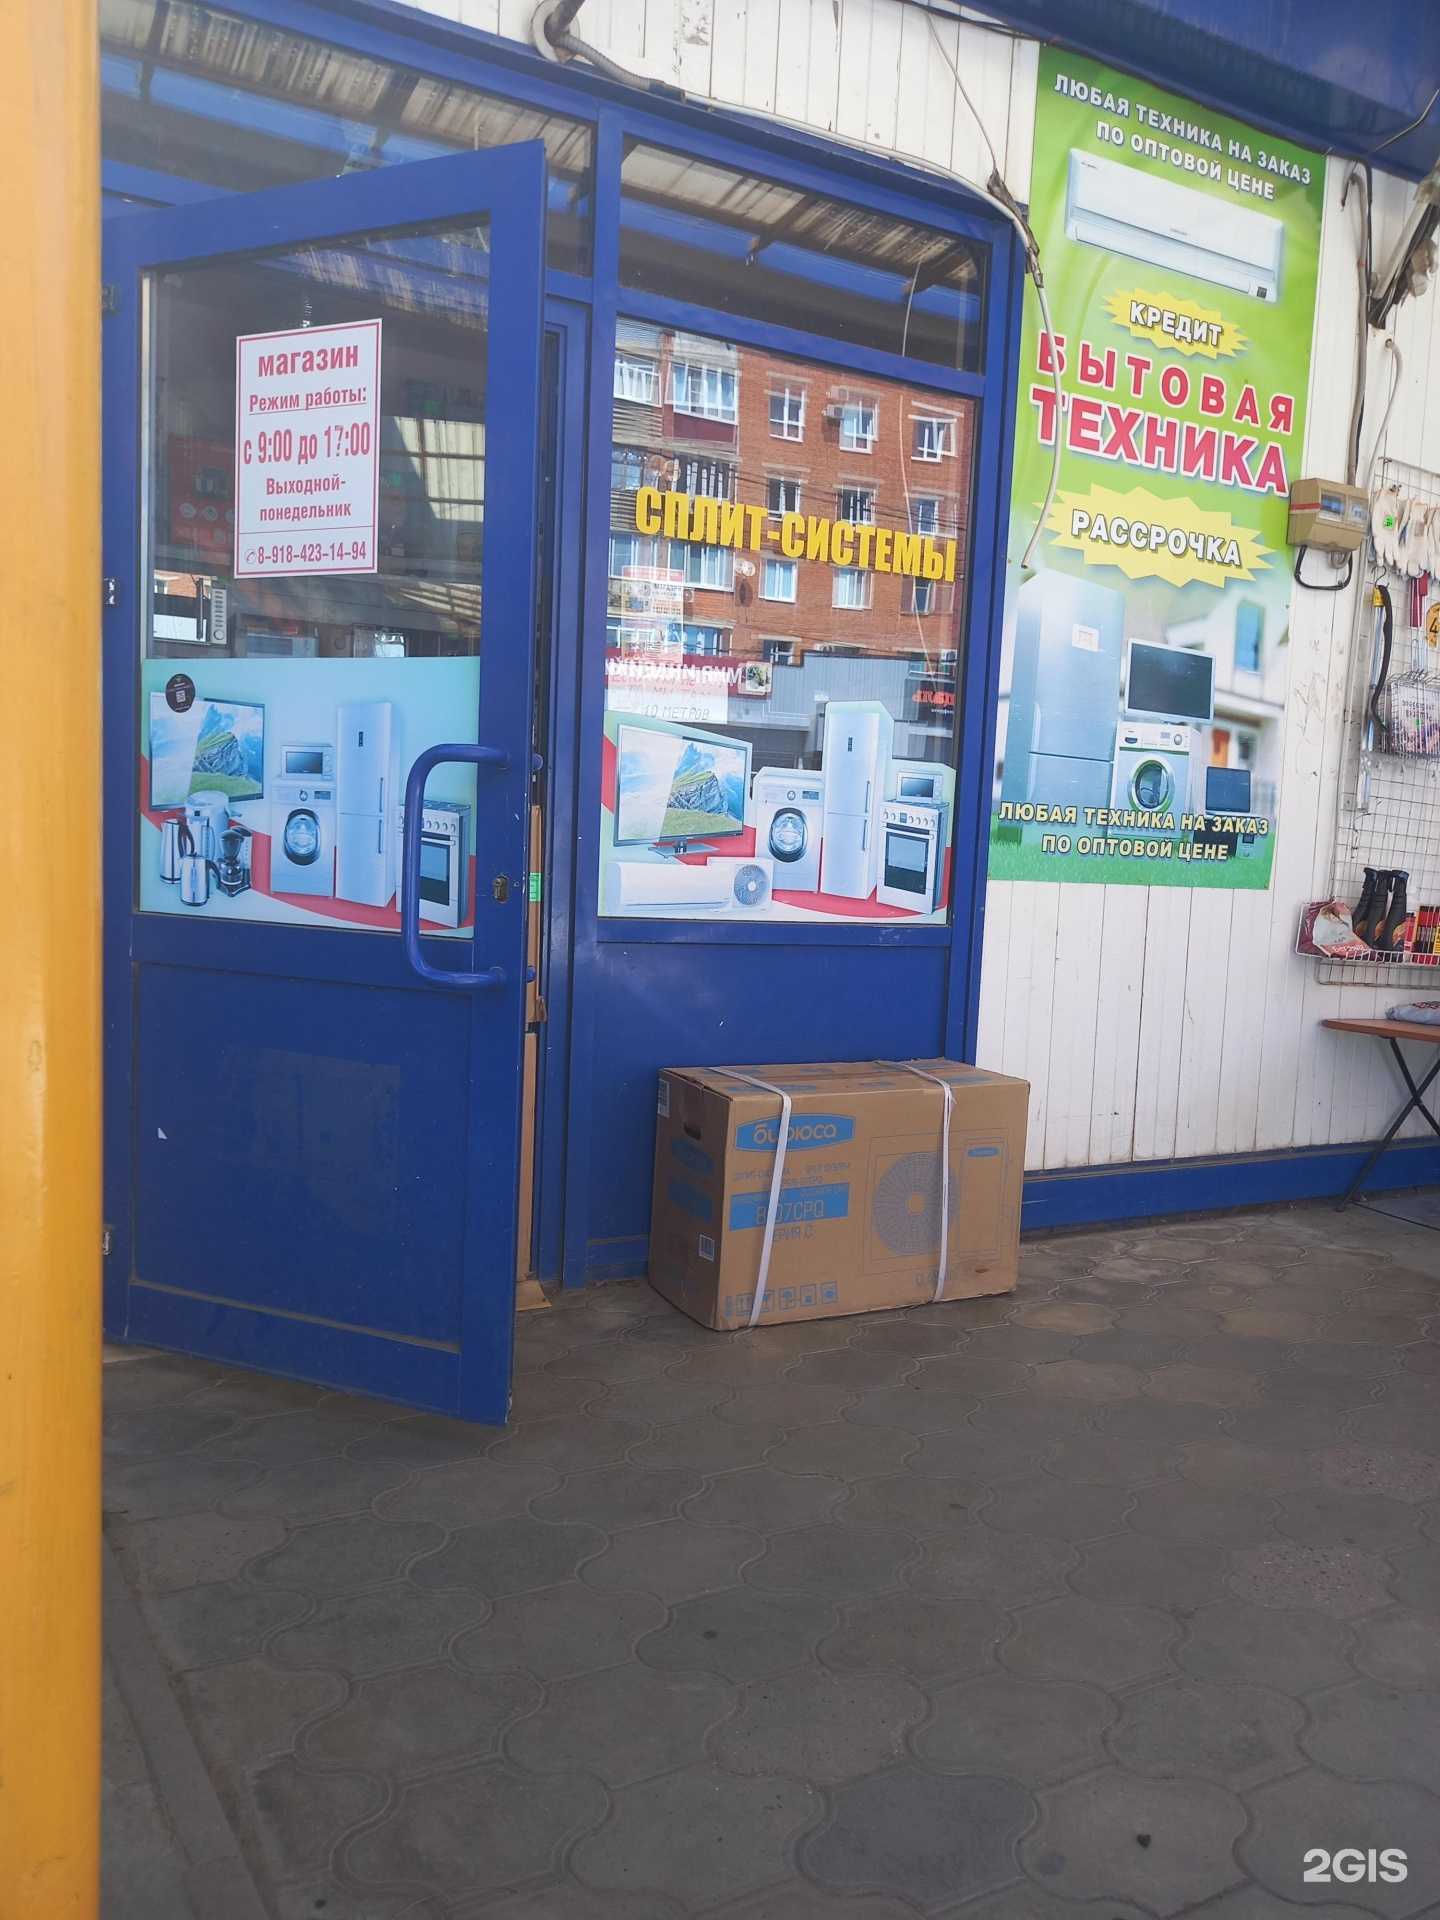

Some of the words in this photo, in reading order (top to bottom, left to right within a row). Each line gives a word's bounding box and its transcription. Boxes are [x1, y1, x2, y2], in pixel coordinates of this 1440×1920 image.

[1054, 73, 1129, 117] ЛЮБАЯ
[1136, 103, 1222, 152] ТЕХНИКА
[1228, 139, 1252, 163] НА
[1258, 147, 1312, 185] ЗАКАЗ
[1096, 121, 1124, 146] ПО
[1131, 134, 1221, 181] ОПТОВОЙ
[1227, 170, 1275, 200] ЦЕНЕ
[1129, 300, 1224, 347] КРЕДИТ
[249, 393, 300, 413] Режим
[305, 386, 367, 411] работы:
[1037, 330, 1294, 434] БЫТОВАЯ
[258, 428, 292, 464] 9:00
[298, 433, 318, 465] до
[323, 422, 371, 459] 17:00
[1031, 386, 1289, 496] ТЕХНИКА
[265, 473, 346, 496] Выходной-
[259, 502, 352, 522] понедельник
[635, 486, 958, 583] СПЛИТ-СИСТЕМЫ
[257, 540, 367, 565] 8-918-423-14-94
[1070, 508, 1242, 567] РАССРОЧКА
[999, 801, 1078, 825] ЛЮБАЯ
[1083, 807, 1175, 832] ТЕХНИКА
[1180, 814, 1207, 833] НА
[1211, 815, 1270, 836] ЗАКАЗ
[1041, 834, 1071, 854] ПО
[1077, 836, 1173, 859] ОПТОВОЙ
[1178, 842, 1229, 862] ЦЕНЕ
